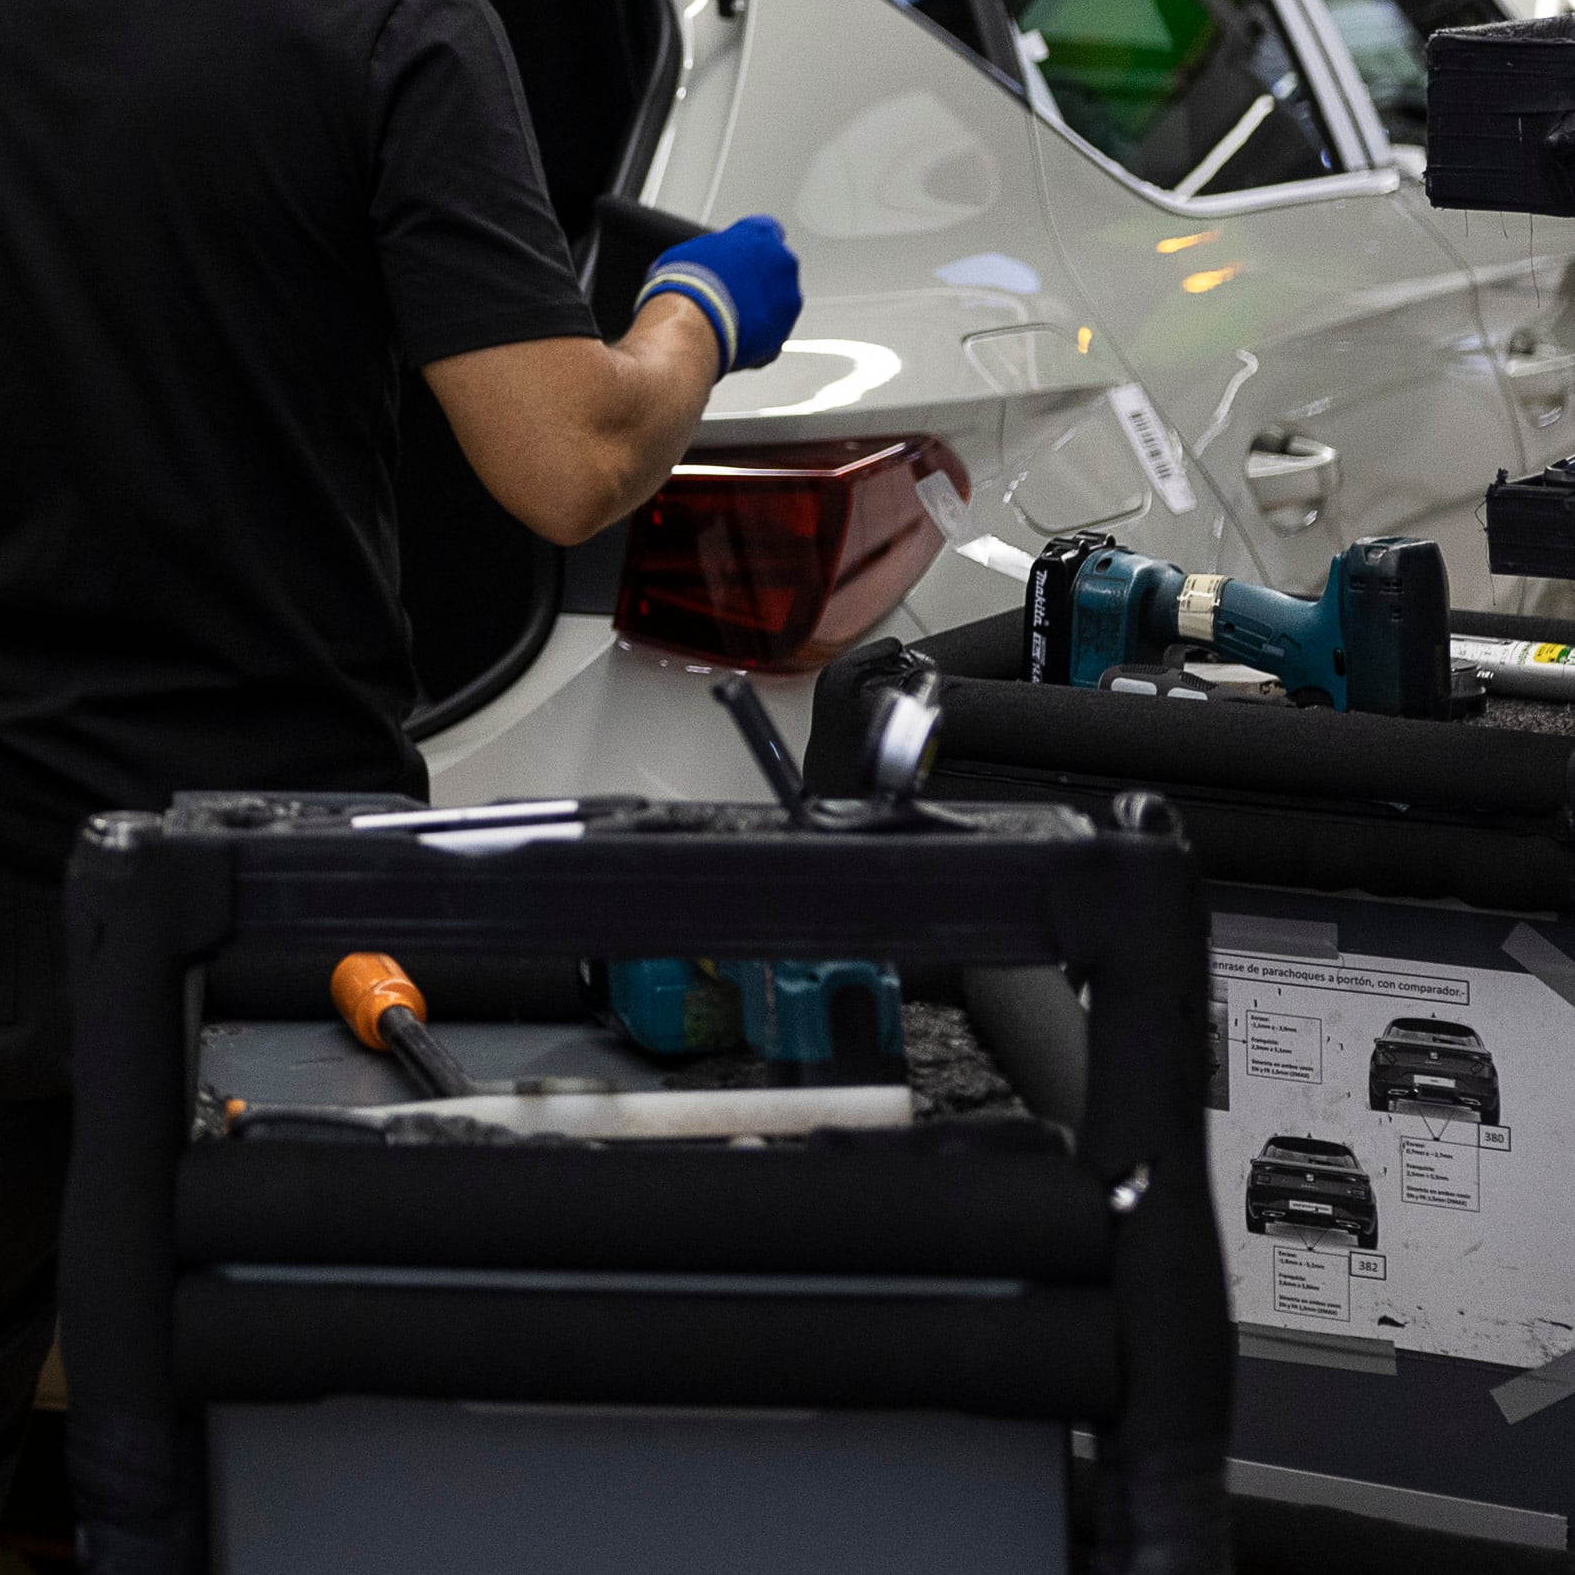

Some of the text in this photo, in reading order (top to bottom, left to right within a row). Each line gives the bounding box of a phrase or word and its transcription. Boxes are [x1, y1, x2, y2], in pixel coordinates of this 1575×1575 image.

[1033, 570, 1048, 627] makita
[1212, 961, 1244, 972] enrase
[1247, 964, 1259, 974] de
[1262, 967, 1325, 981] parachoques
[1327, 975, 1334, 983] a
[1337, 976, 1375, 988] portón,
[1378, 980, 1395, 989] con
[1485, 1132, 1505, 1143] 380
[1358, 1261, 1378, 1272] 382
